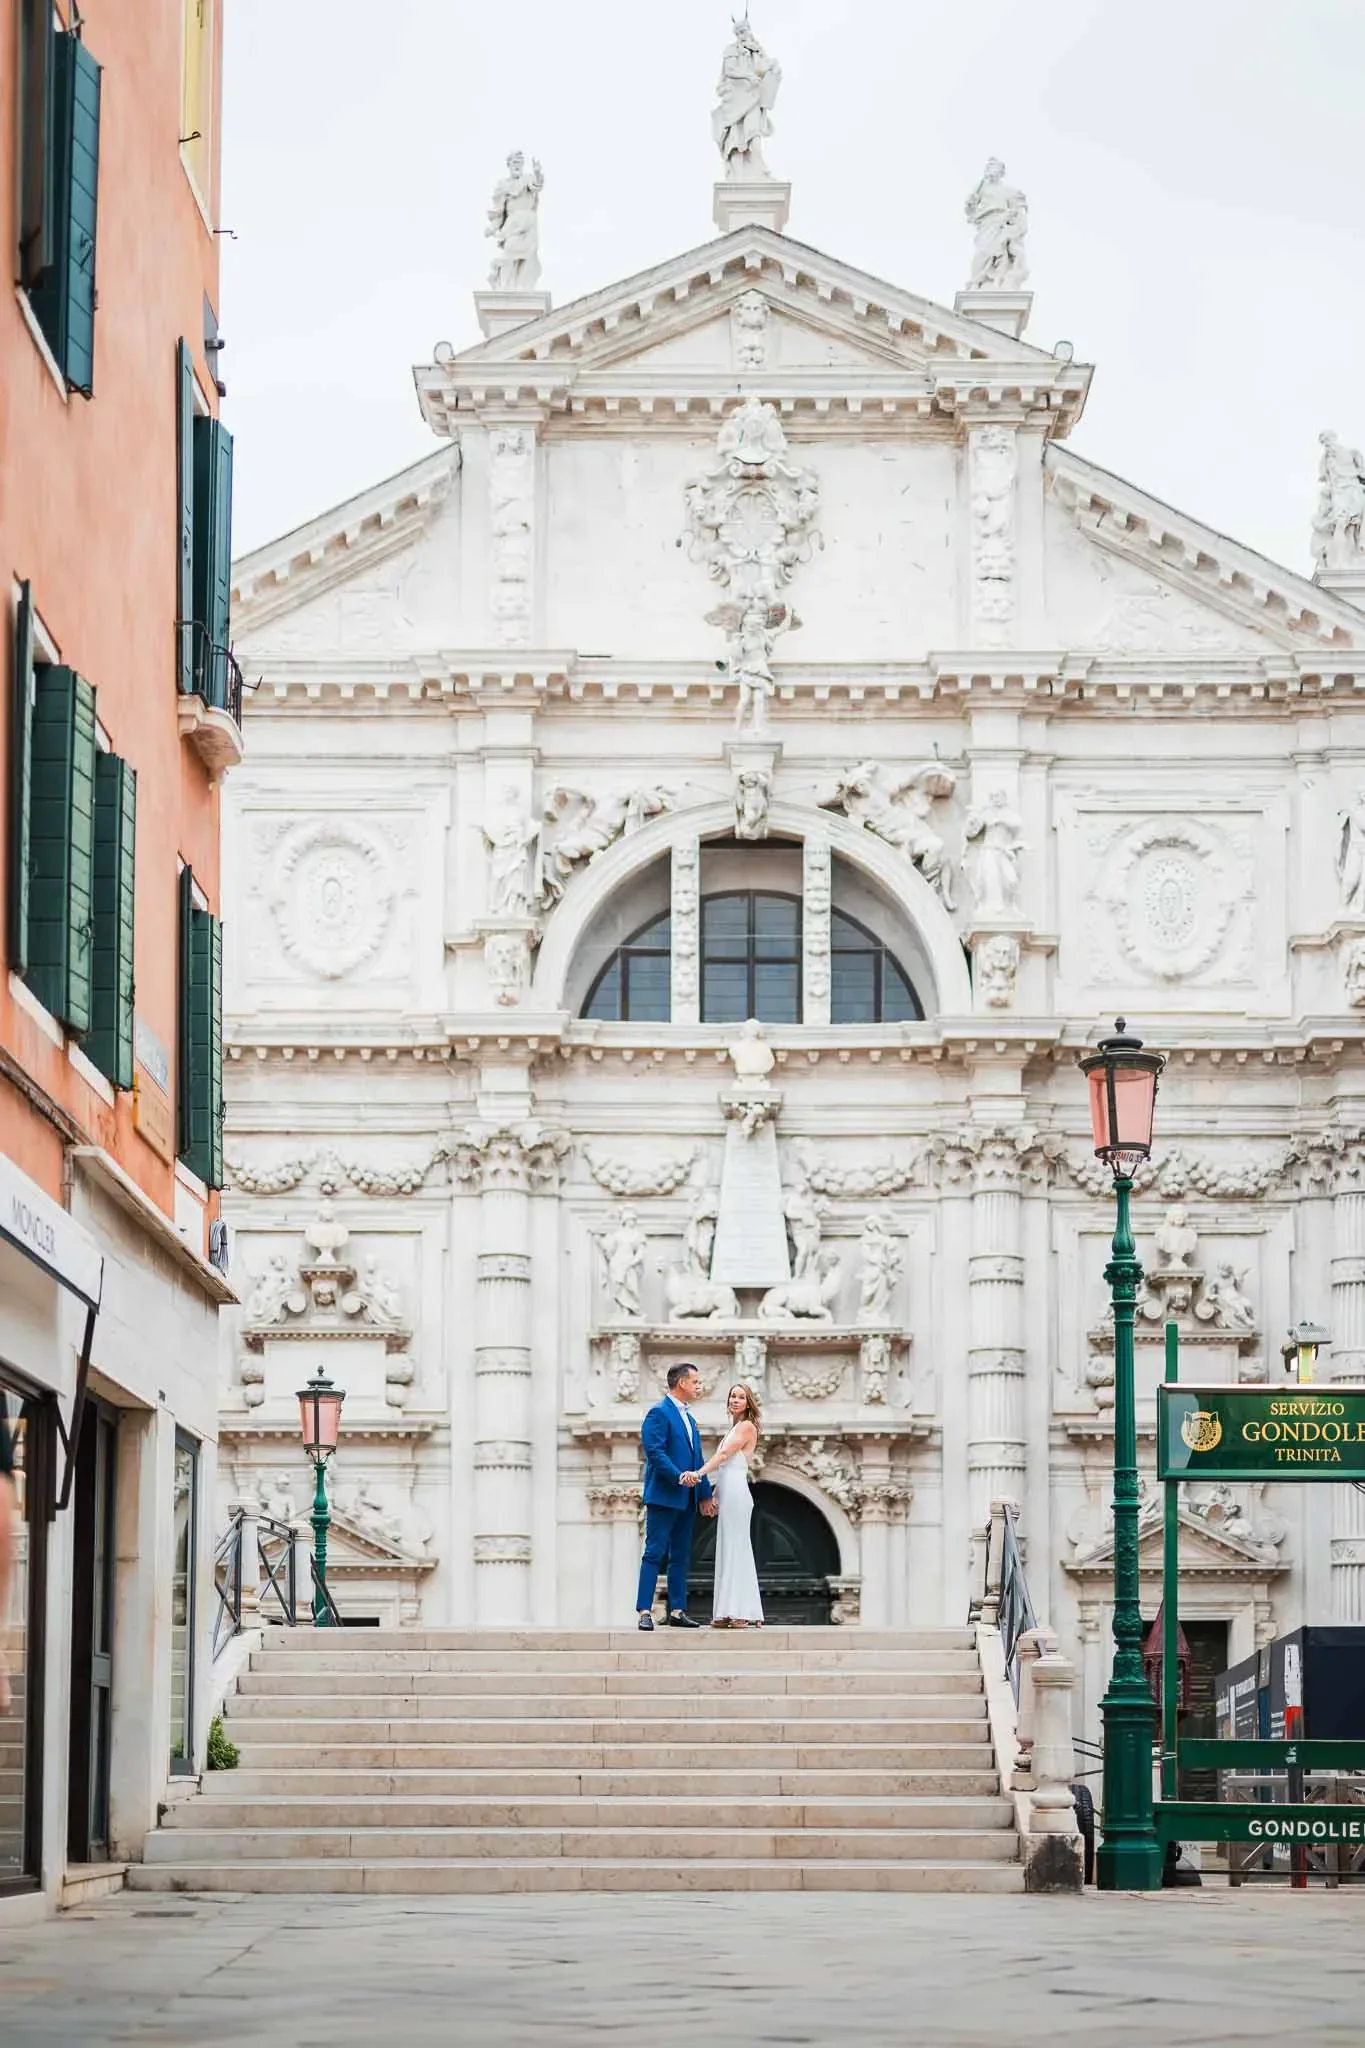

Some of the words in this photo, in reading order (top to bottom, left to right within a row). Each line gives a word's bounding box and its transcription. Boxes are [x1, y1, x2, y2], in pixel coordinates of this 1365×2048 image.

[1270, 1402, 1345, 1416] SERVIZIO
[1274, 1446, 1342, 1461] TRINITÀ
[1248, 1820, 1365, 1838] GONDOLIE
